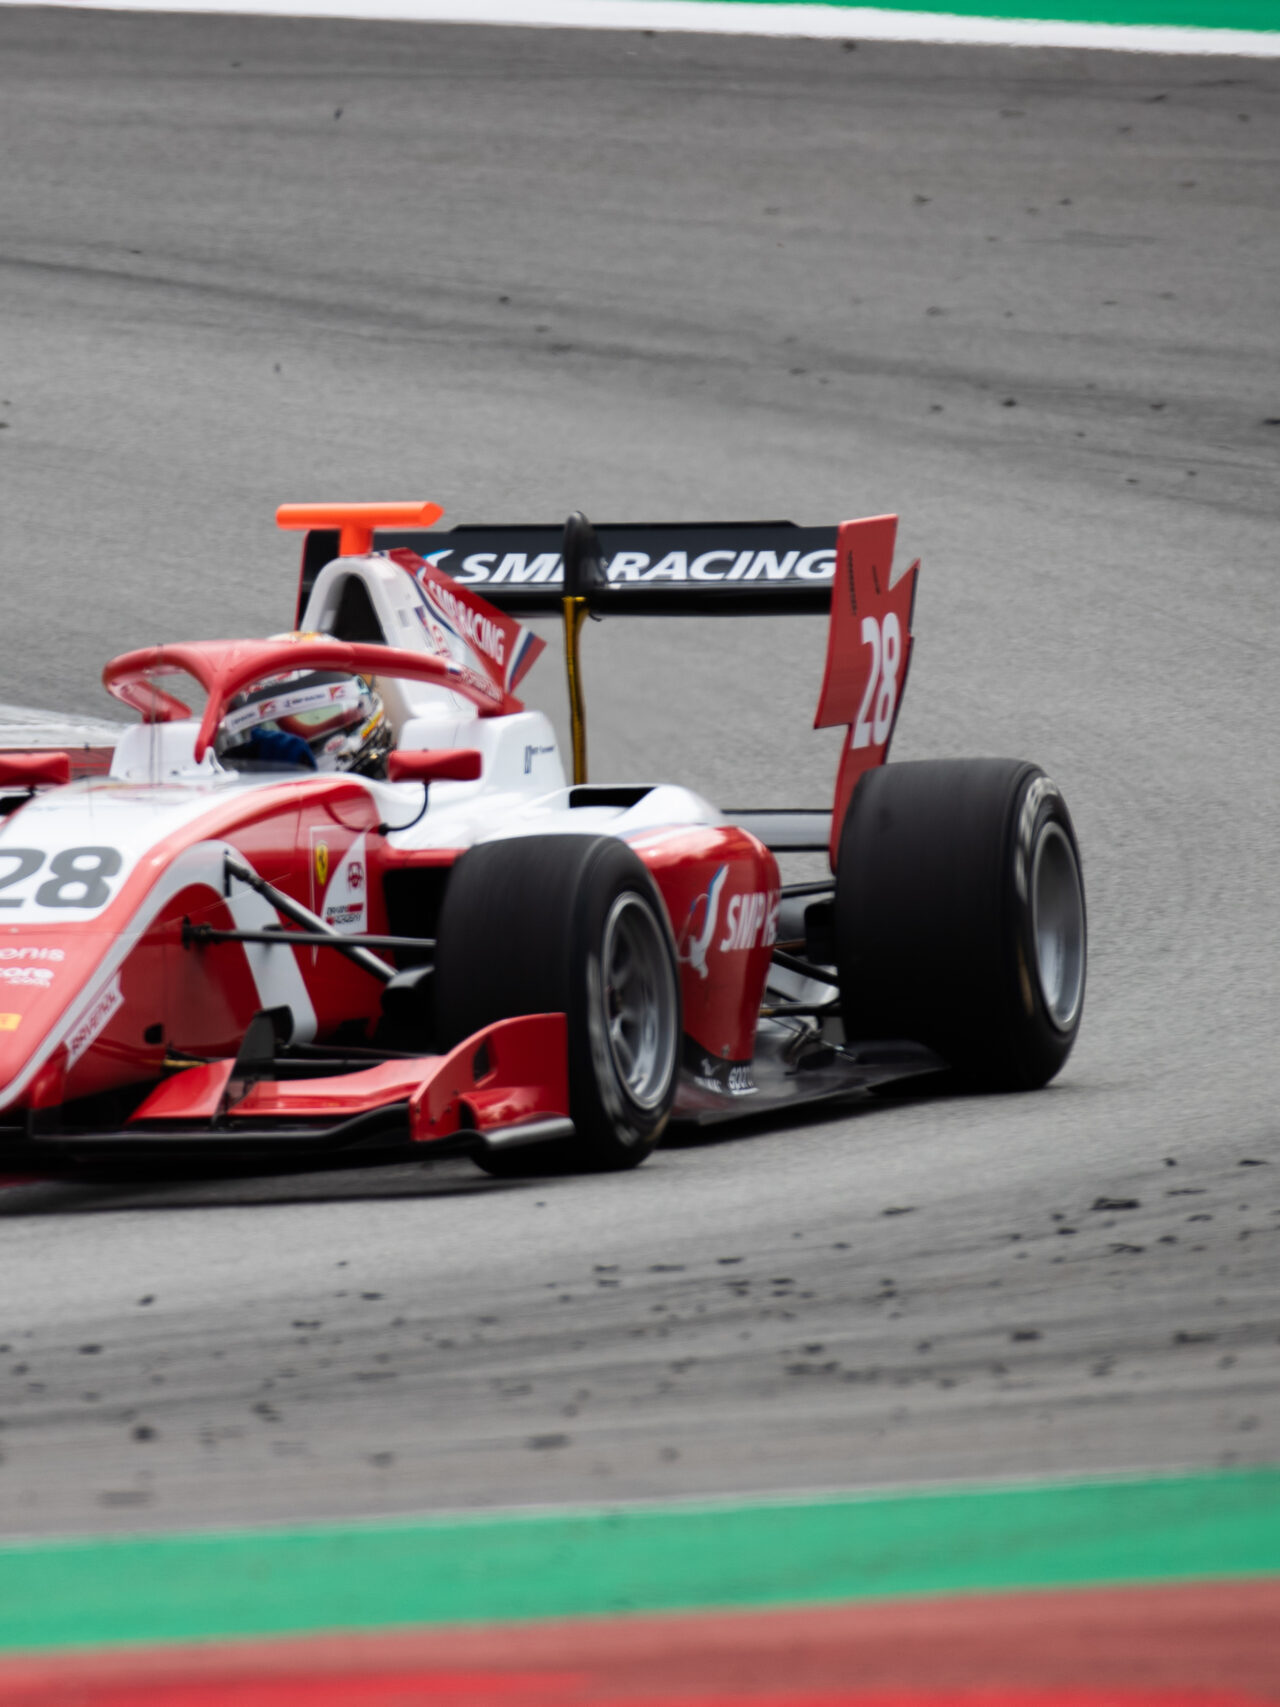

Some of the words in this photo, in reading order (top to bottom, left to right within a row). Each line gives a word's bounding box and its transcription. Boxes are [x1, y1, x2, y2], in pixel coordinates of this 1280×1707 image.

[454, 552, 580, 584] SM
[607, 549, 838, 581] RACING
[851, 612, 902, 750] 28
[720, 891, 766, 953] SMP
